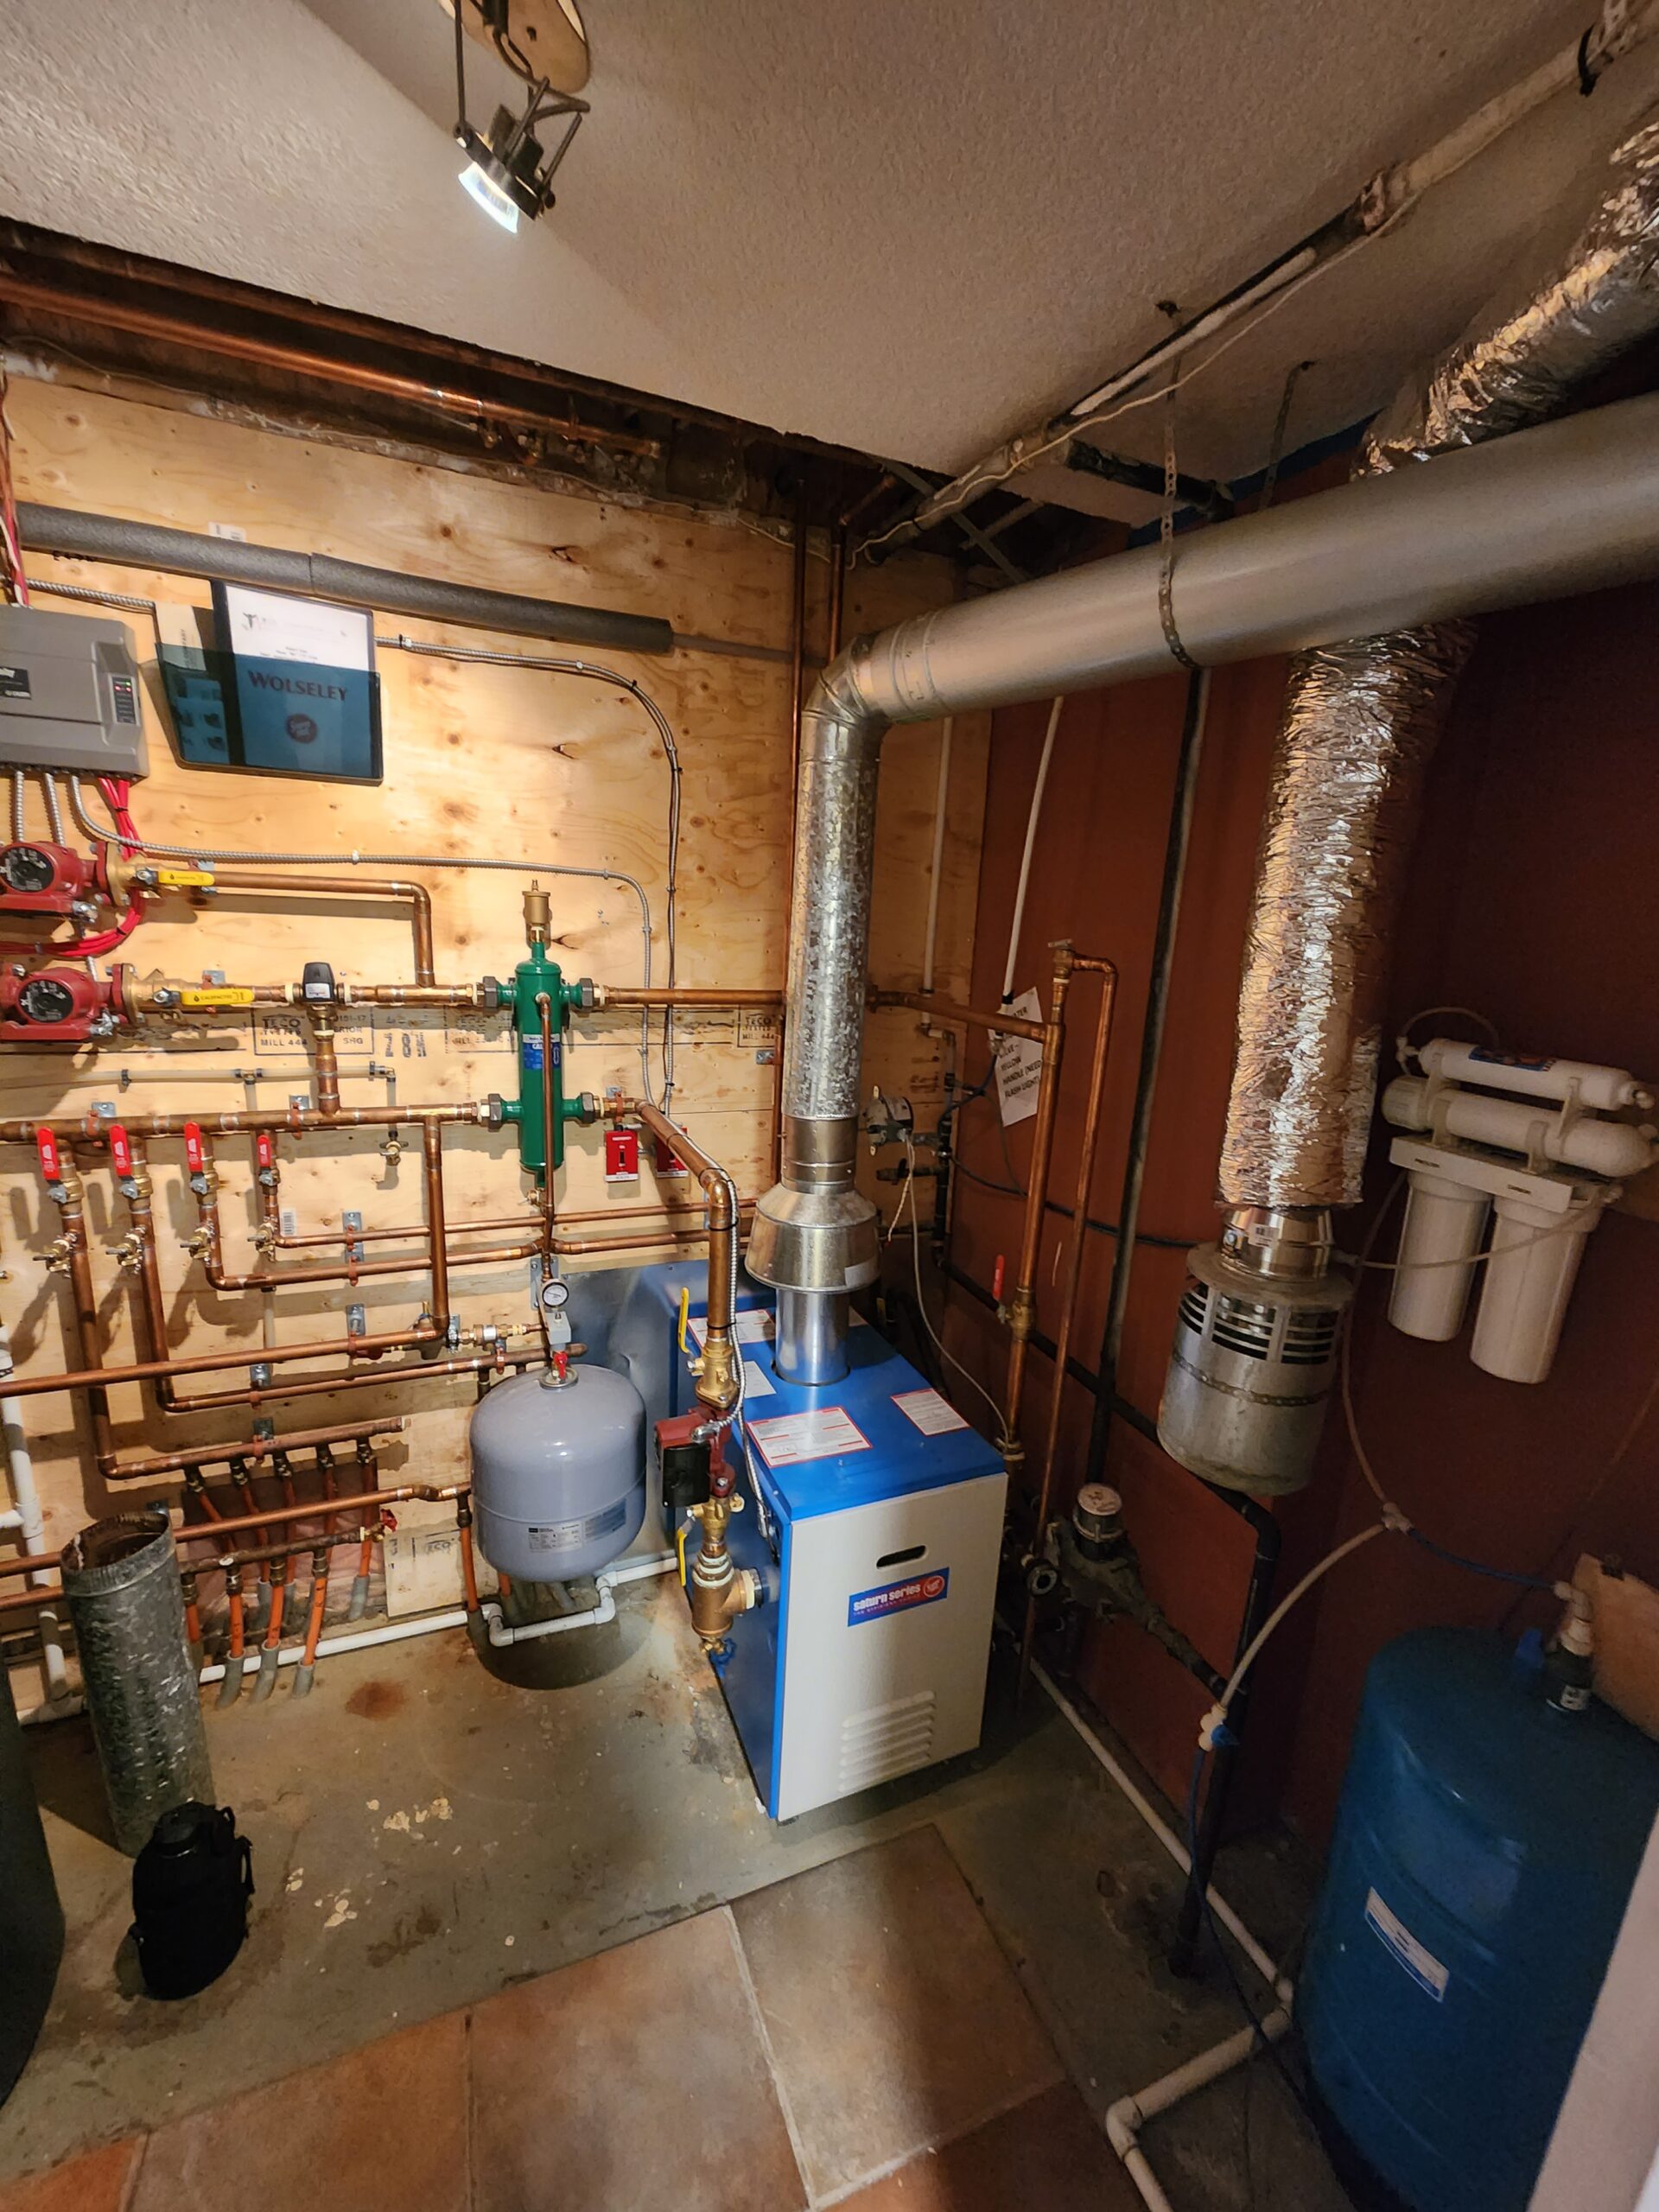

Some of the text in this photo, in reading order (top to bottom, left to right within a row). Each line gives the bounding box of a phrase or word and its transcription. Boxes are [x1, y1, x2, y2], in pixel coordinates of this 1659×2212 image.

[248, 671, 347, 702] WOLSELEY
[262, 1017, 301, 1028] TECO
[1002, 1068, 1024, 1085] HANDLE
[1004, 1085, 1021, 1098] FLASH
[854, 1592, 888, 1612] saturn
[889, 1584, 921, 1601] series
